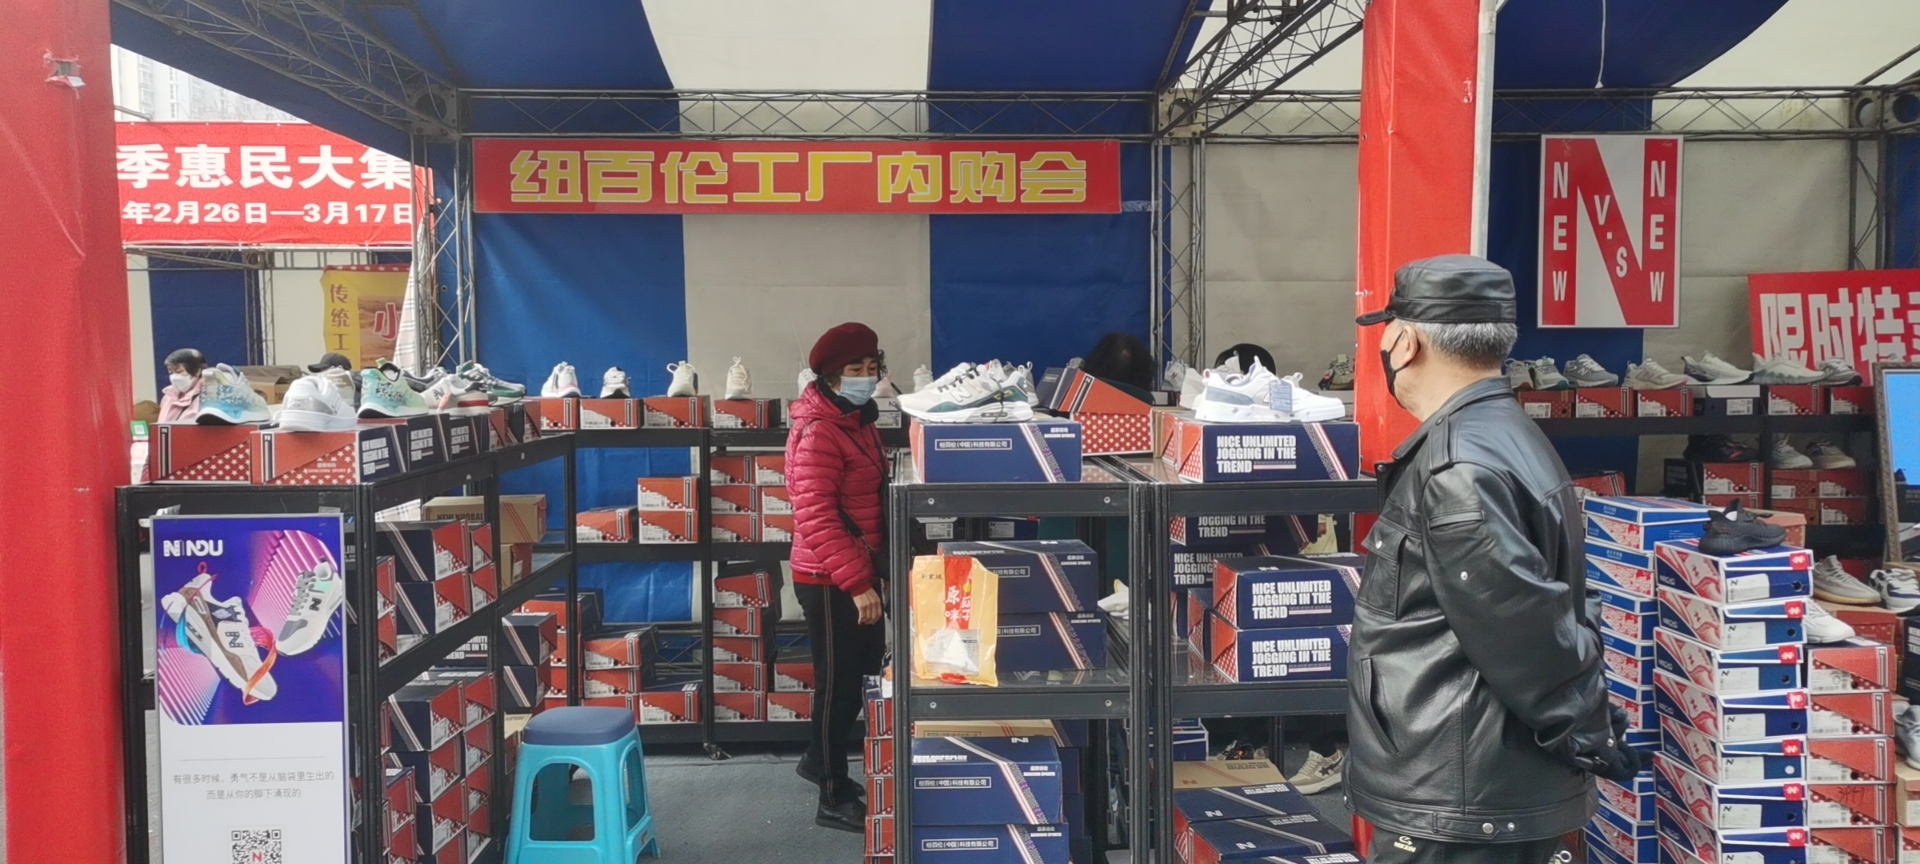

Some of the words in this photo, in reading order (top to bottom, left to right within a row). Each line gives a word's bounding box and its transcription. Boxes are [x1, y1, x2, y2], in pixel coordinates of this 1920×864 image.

[509, 150, 1087, 204] 纽百伦工厂内购会
[1552, 161, 1569, 301] NEW
[1649, 160, 1666, 302] NEW
[1217, 435, 1241, 448] NICE
[1242, 435, 1296, 448] UNLIMITED
[1217, 447, 1261, 460] JOGGING
[1263, 447, 1274, 459] IN
[1277, 447, 1296, 459] THE
[1217, 460, 1252, 473] TREND
[1198, 515, 1236, 526] JOGGING
[1238, 515, 1247, 526] IN
[1249, 514, 1266, 525] THE
[1198, 526, 1228, 538] TREND
[1174, 553, 1195, 563] NICE
[1174, 563, 1213, 574] JOGGING
[1174, 574, 1205, 585] TREND
[1252, 582, 1276, 594] NICE
[1277, 580, 1331, 593] UNLIMITED
[1252, 593, 1297, 606] JOGGING
[1299, 593, 1310, 605] IN
[1312, 592, 1332, 605] THE
[1252, 606, 1288, 620] TREND
[1252, 640, 1276, 652] NICE
[1277, 637, 1331, 651] UNLIMITED
[1252, 651, 1297, 664] JOGGING
[1299, 651, 1310, 663] IN
[1312, 650, 1332, 662] THE
[1252, 664, 1288, 678] TREND
